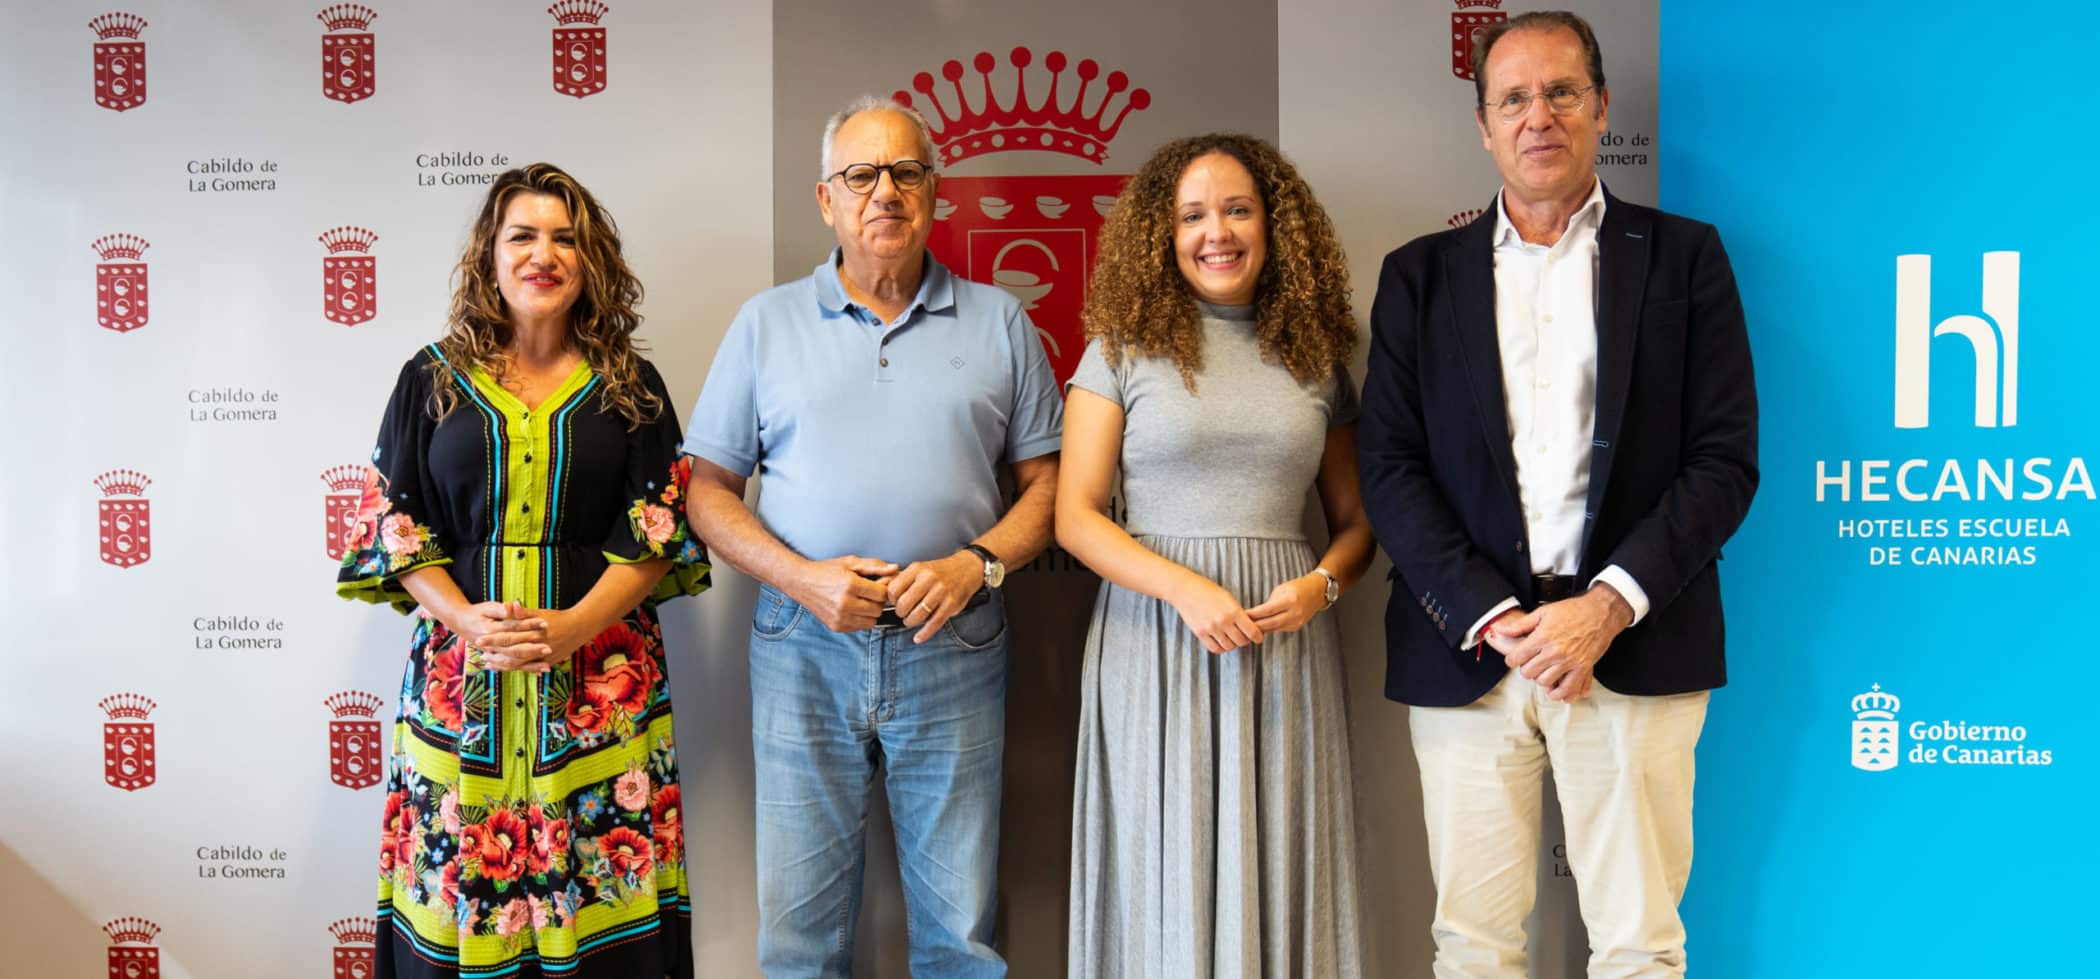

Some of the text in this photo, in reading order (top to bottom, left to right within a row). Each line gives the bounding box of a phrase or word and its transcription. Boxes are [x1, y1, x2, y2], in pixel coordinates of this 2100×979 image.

[1632, 133, 1650, 146] de
[187, 159, 278, 174] Cabildo de
[416, 152, 509, 168] Cabildo de
[1595, 153, 1648, 166] omera
[189, 178, 276, 193] La Gomera
[418, 171, 499, 187] La Gomer
[188, 388, 279, 403] Cabildo de
[190, 408, 277, 422] La Gomera
[1815, 457, 2097, 502] HECANSA
[1838, 518, 2071, 538] HOTELES ESCUELA
[1869, 546, 2037, 566] DE CANARIAS
[193, 616, 284, 632] Cabildo de
[194, 635, 282, 650] La Gomera
[1908, 720, 2027, 741] Gobierno
[1908, 743, 2053, 765] de Canarias
[196, 845, 287, 861] Cabildo de
[198, 864, 285, 879] La Gomera
